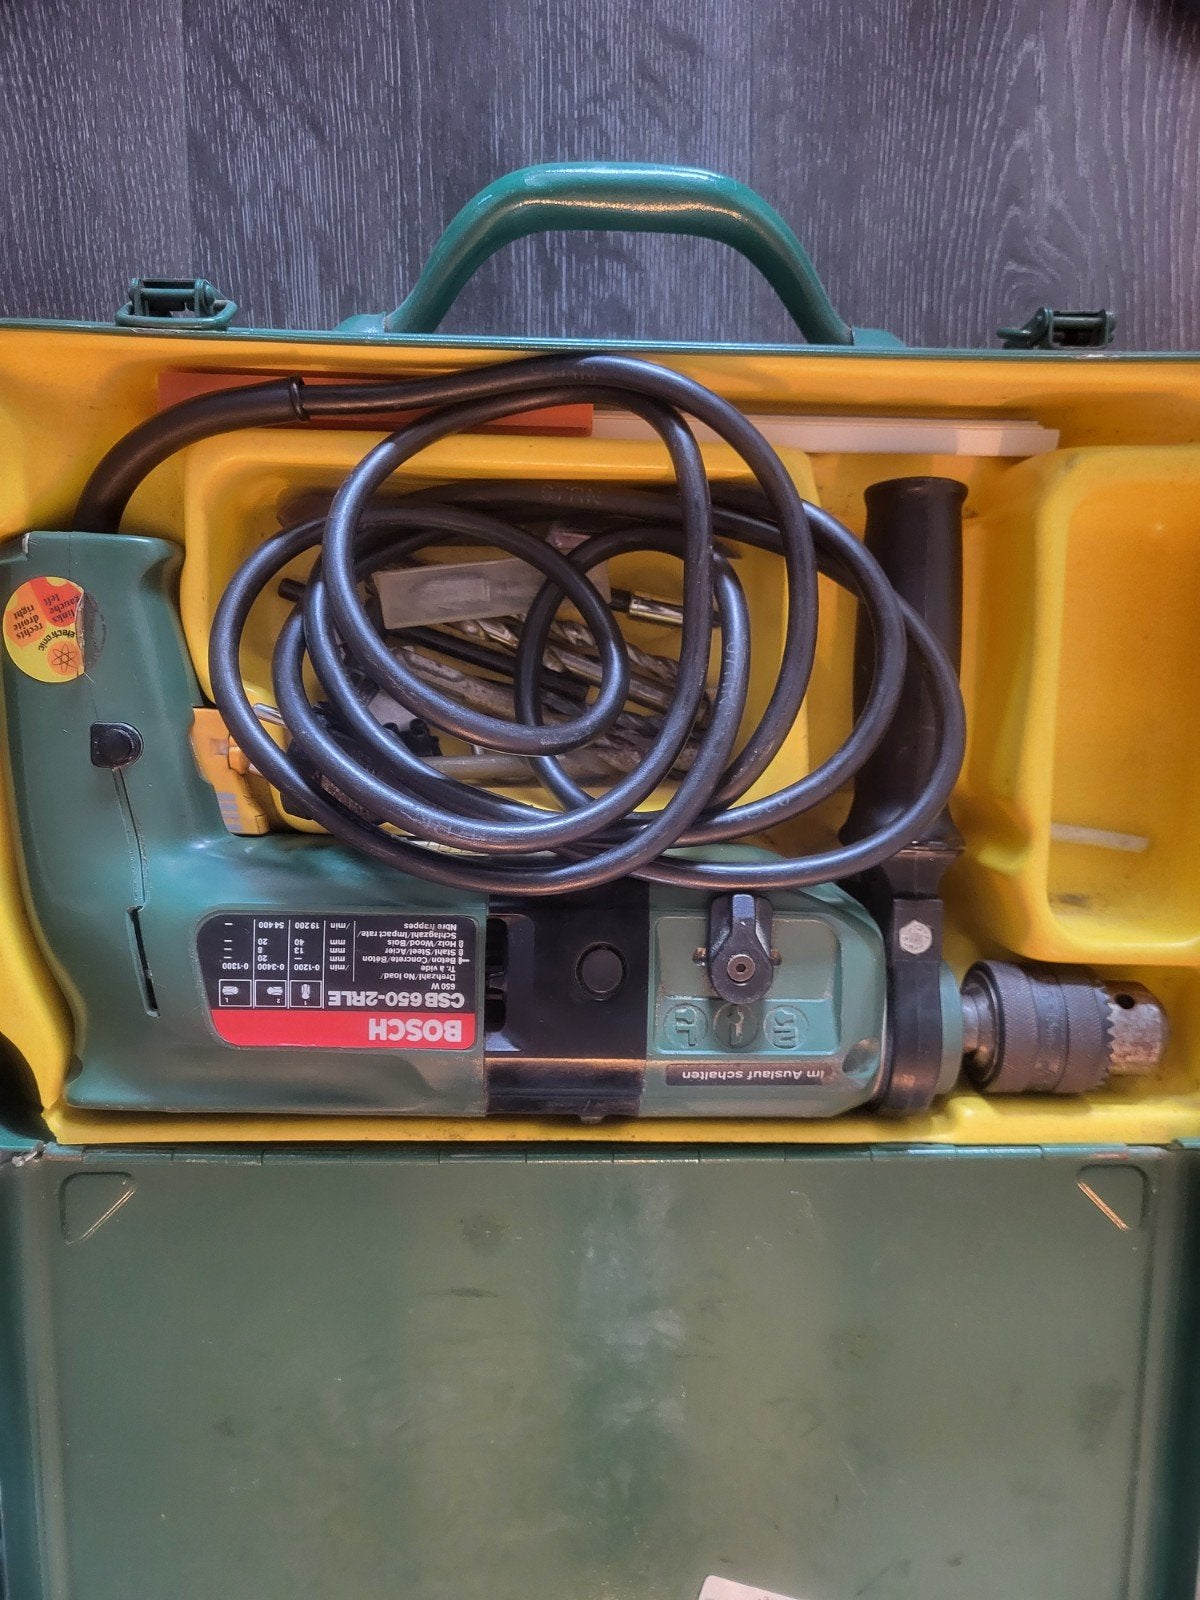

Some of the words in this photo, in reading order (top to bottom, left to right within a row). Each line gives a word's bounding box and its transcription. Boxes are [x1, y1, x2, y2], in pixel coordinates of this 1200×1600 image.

[43, 593, 60, 605] left
[13, 605, 34, 619] right
[52, 610, 75, 624] links
[13, 615, 39, 631] droite
[16, 623, 43, 640] rechts
[404, 922, 435, 931] frappes
[379, 930, 456, 939] Schlagzahl/Impact
[387, 939, 456, 947] Holz/Wood/Bois
[385, 948, 456, 956] Stahl/Steel/Acier
[362, 956, 456, 964] Beton/Concrete/Béton
[404, 973, 455, 981] Drehzahl/No
[328, 991, 422, 1007] 650-2RLE
[424, 992, 465, 1008] CSB
[368, 1017, 462, 1042] BOSCH
[682, 1070, 743, 1081] schalten
[746, 1070, 803, 1080] Auslauf
[806, 1070, 824, 1080] Im
